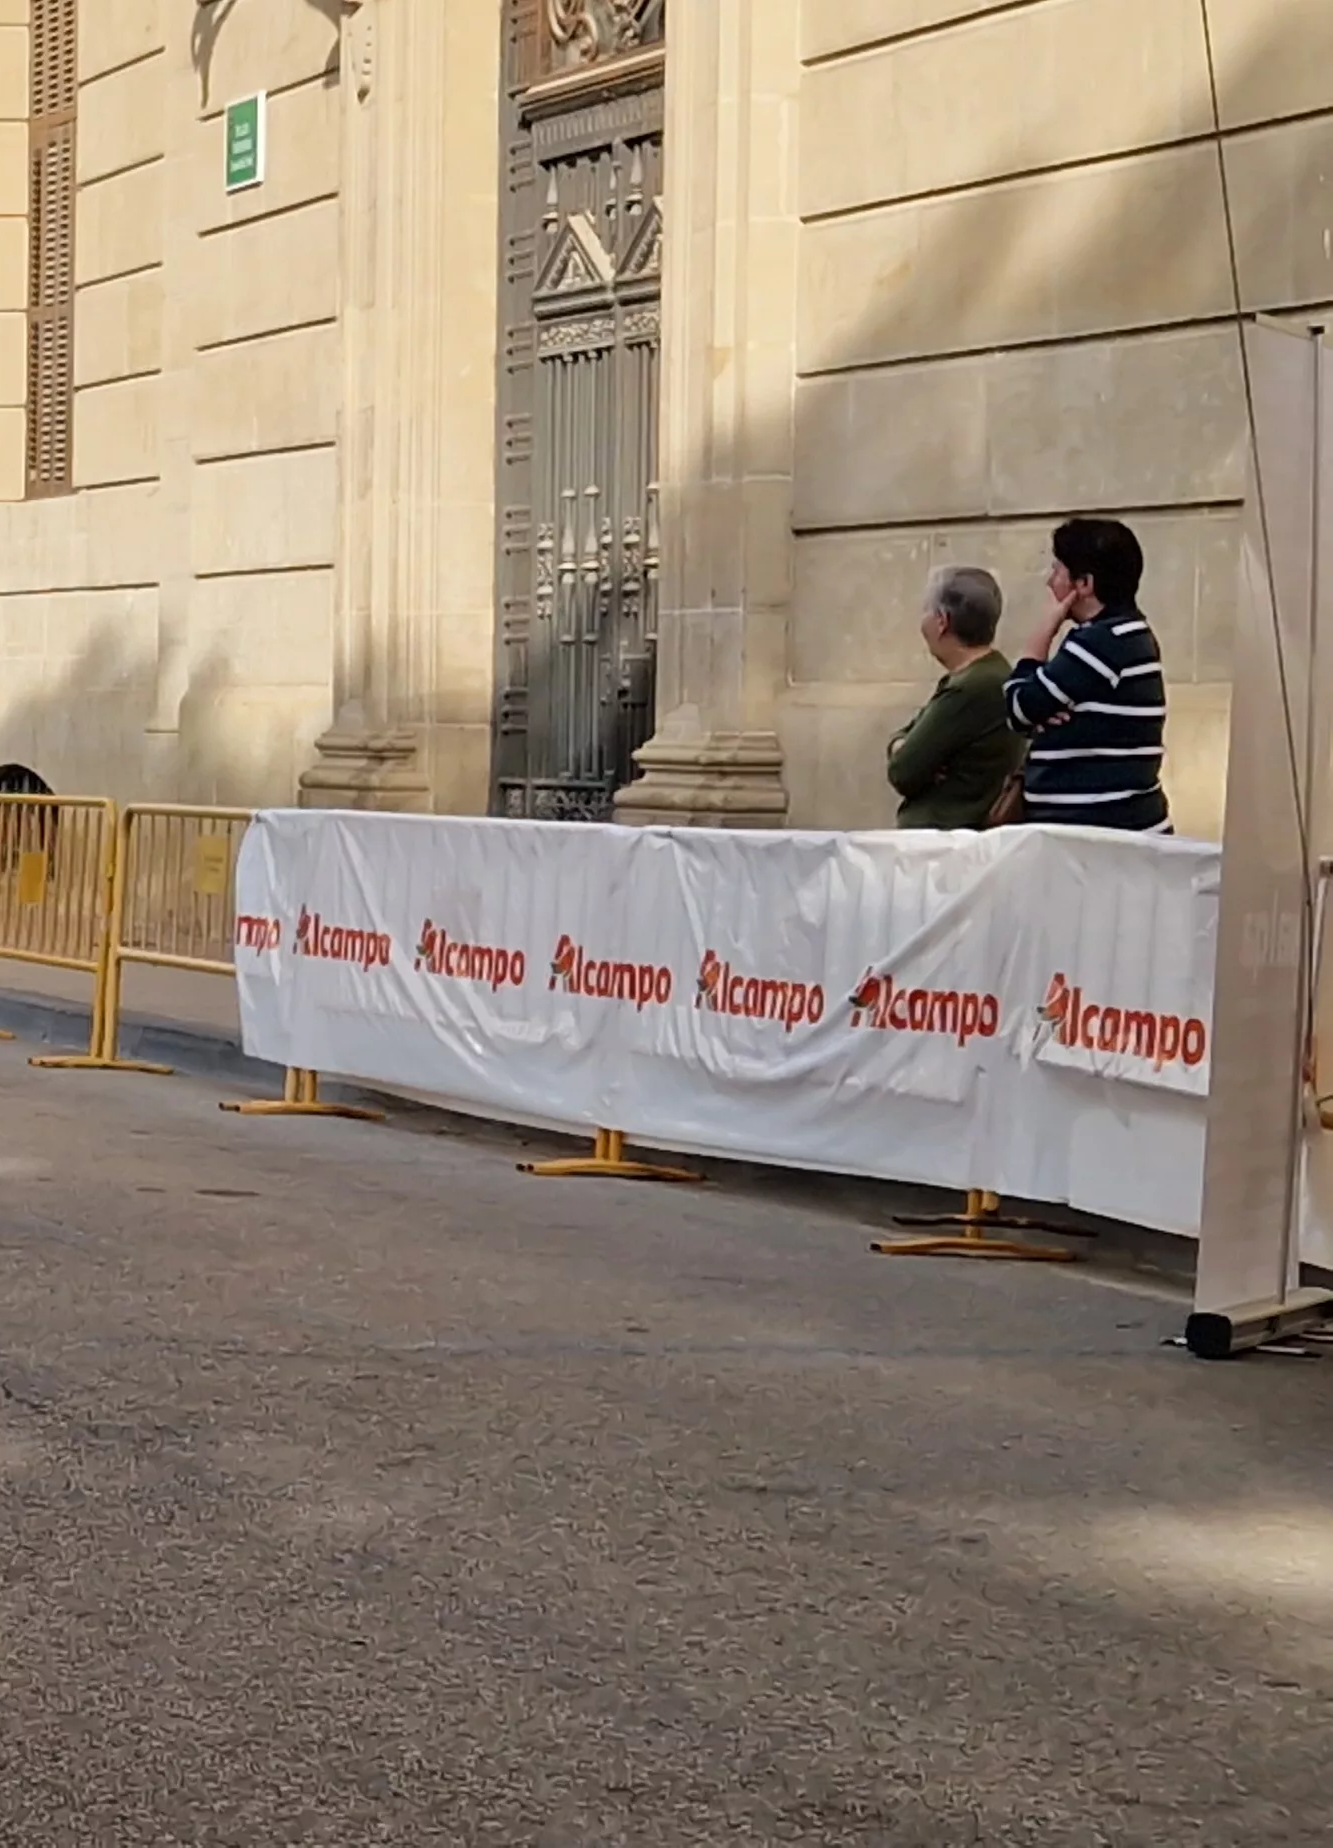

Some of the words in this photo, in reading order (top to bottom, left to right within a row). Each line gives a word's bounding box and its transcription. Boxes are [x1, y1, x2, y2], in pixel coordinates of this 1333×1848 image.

[292, 903, 392, 973] Alcampo
[413, 917, 526, 994] Alcampo
[547, 933, 672, 1014] Alcampo
[694, 948, 825, 1034] Alcampo
[848, 965, 1000, 1048] Alcampo
[1033, 972, 1206, 1074] Alcampo
